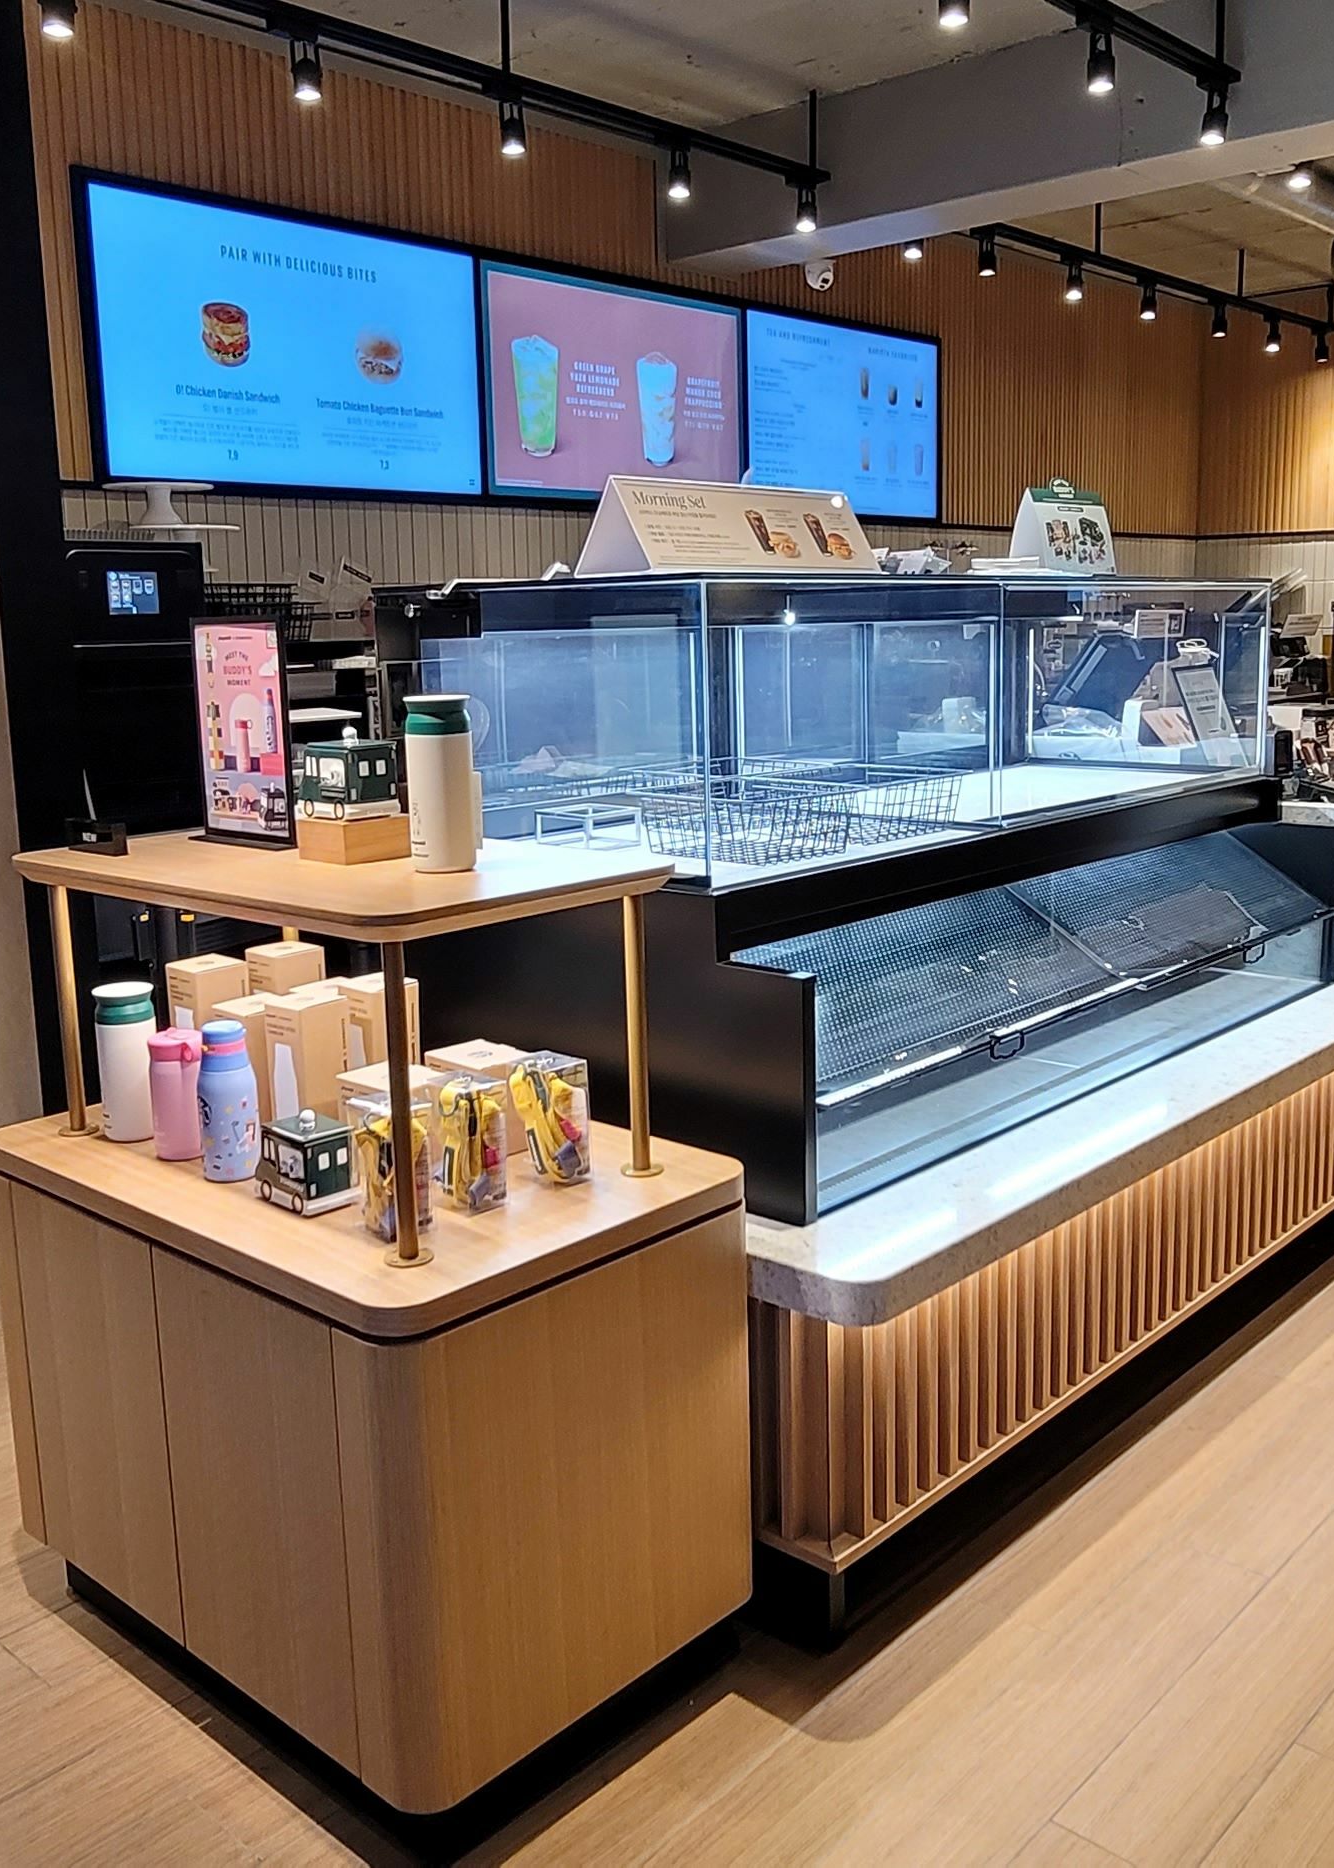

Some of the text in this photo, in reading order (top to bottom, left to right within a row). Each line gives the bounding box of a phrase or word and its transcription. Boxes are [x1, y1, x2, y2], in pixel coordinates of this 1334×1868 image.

[220, 245, 377, 283] PAIR WITH DELICIOUS BITES
[185, 385, 216, 399] Chicken
[217, 388, 244, 401] Danish
[245, 391, 280, 403] Sandwich
[316, 398, 443, 419] Tomato Chicken Baguette Bun Sandwich
[631, 490, 706, 510] Morning Set
[223, 665, 252, 675] BUDDY'S
[227, 678, 251, 687] MOMENT
